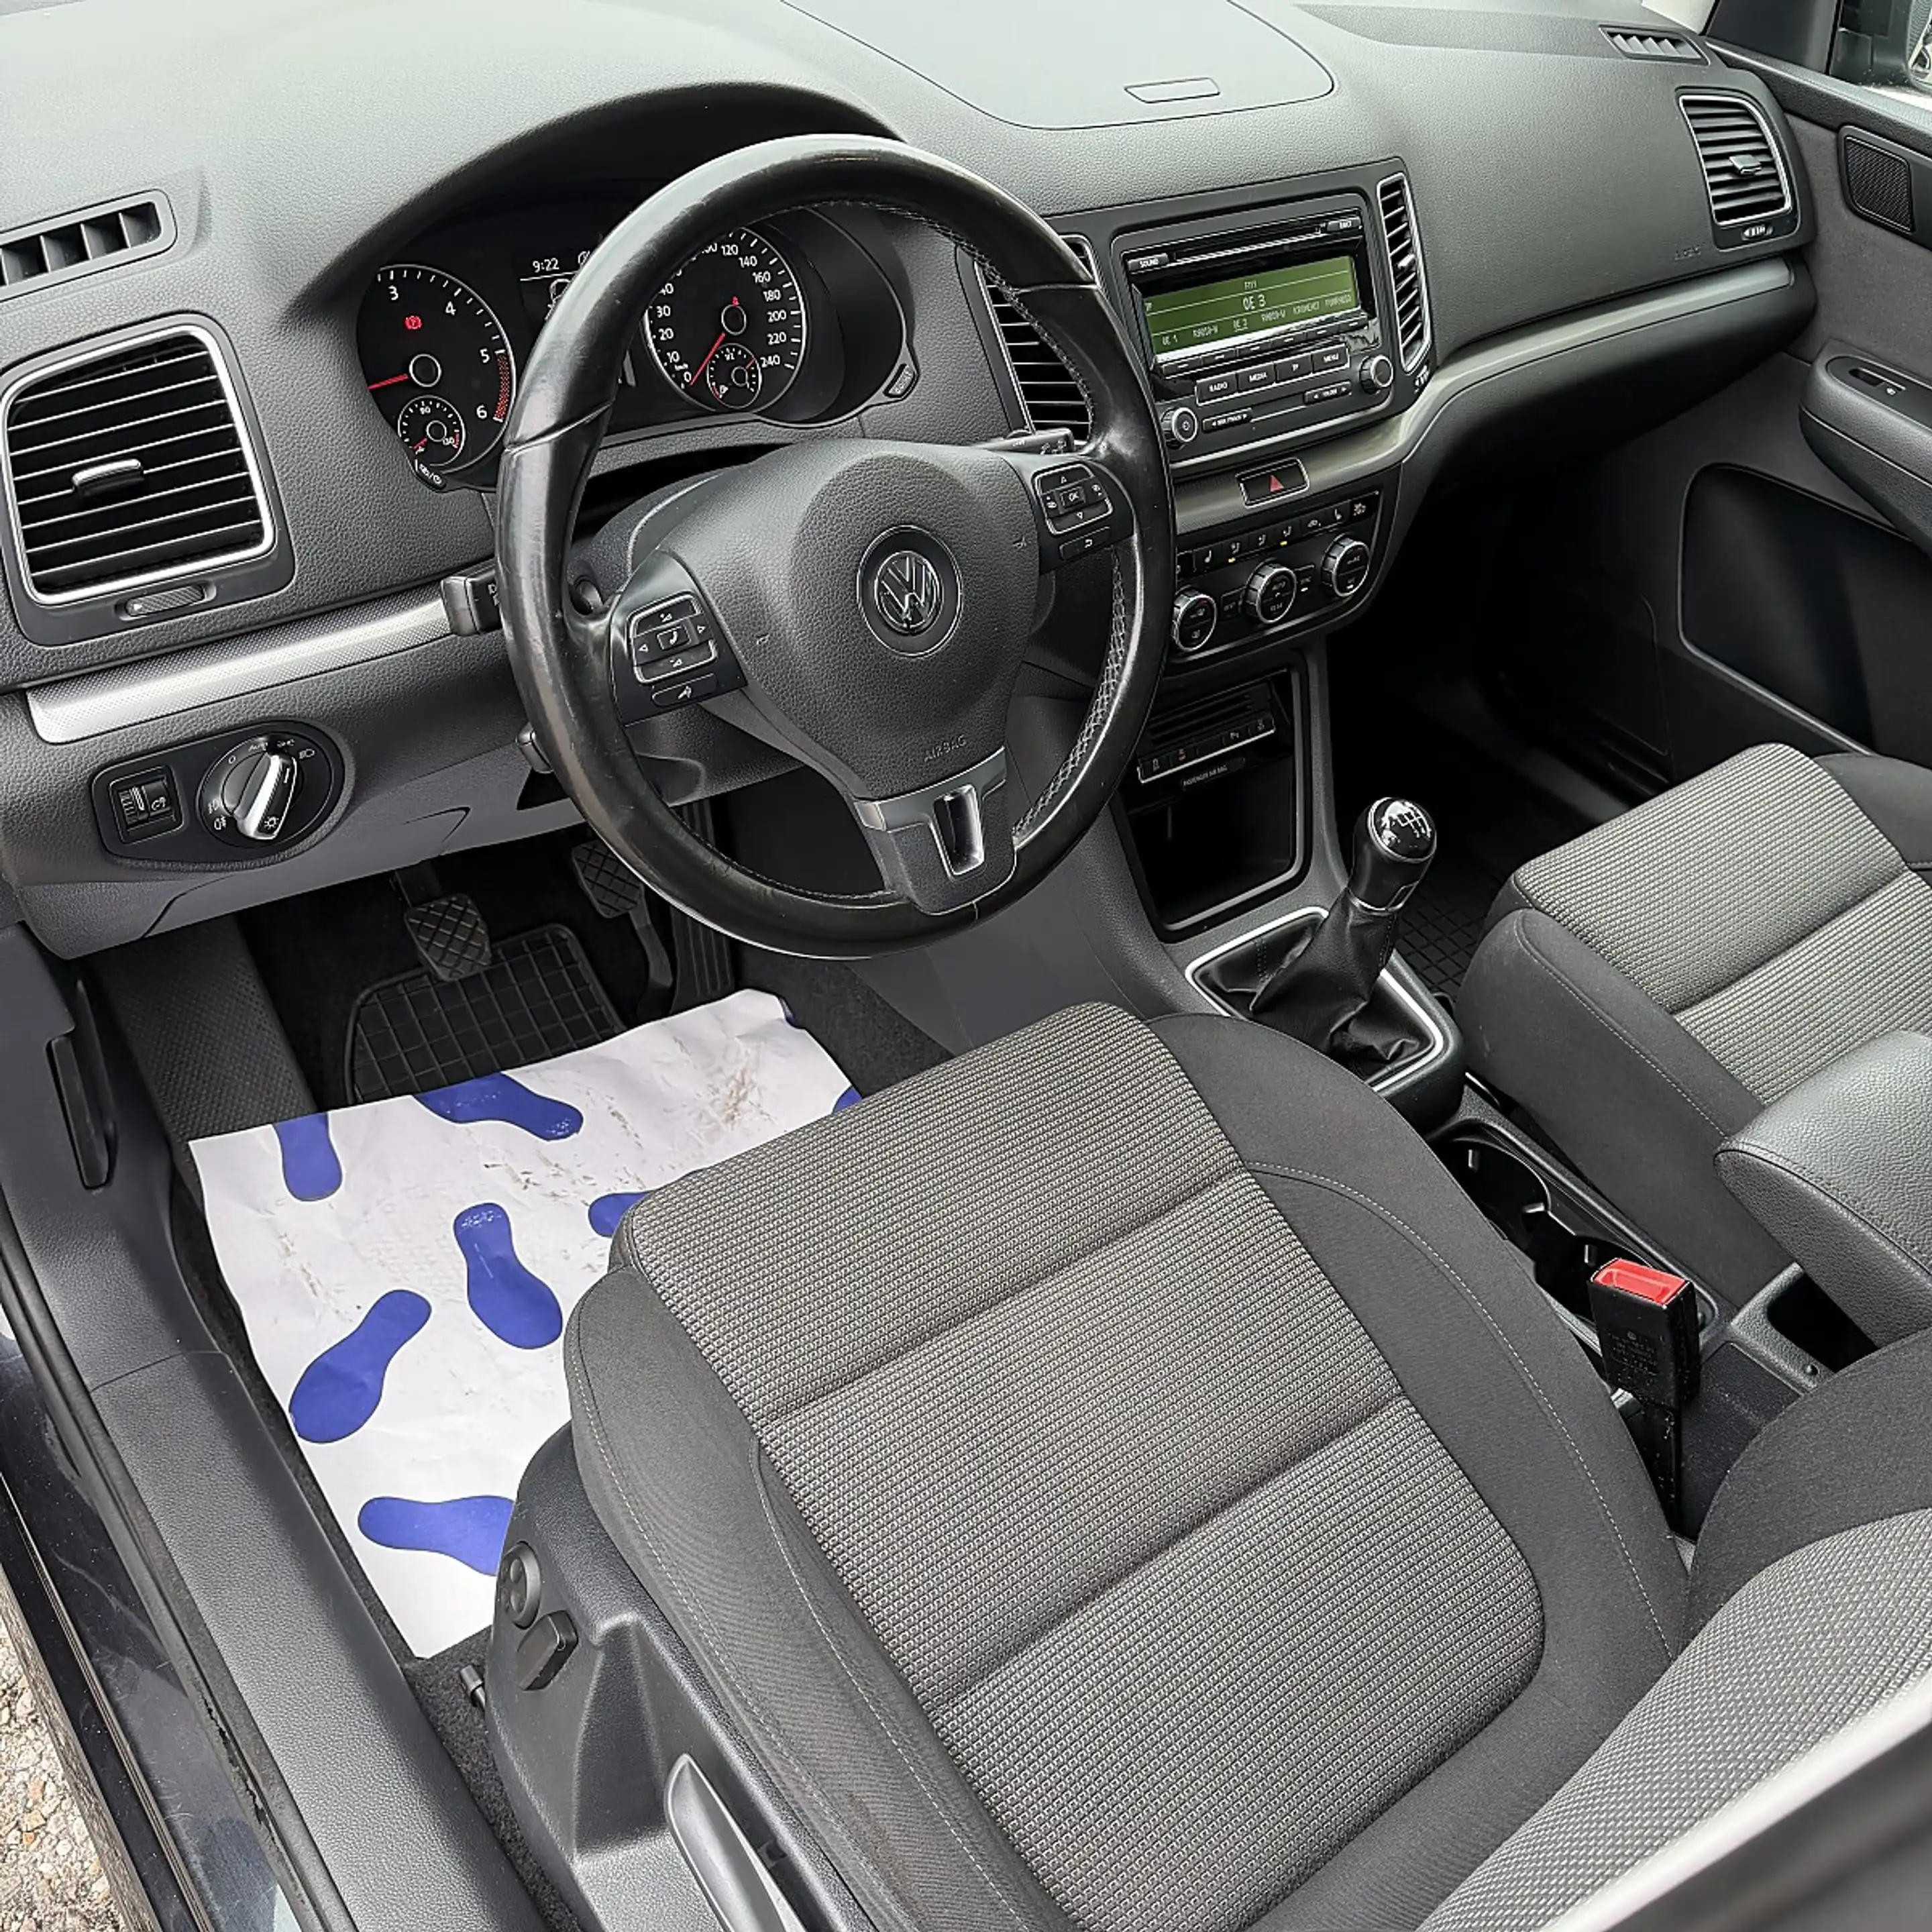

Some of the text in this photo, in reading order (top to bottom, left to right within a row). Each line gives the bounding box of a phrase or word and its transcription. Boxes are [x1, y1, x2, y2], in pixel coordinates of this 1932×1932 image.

[721, 244, 739, 256] 120
[533, 258, 559, 273] 9:22
[738, 256, 757, 267] 140
[752, 270, 771, 282] 160
[388, 285, 398, 301] 3
[763, 289, 781, 302] 180
[1258, 294, 1267, 307] 3
[445, 301, 456, 315] 4
[656, 305, 671, 318] 30
[767, 309, 787, 322] 200
[658, 327, 674, 341] 20
[767, 331, 787, 345] 220
[480, 348, 490, 363] 5
[666, 351, 680, 363] 10
[759, 354, 780, 368] 240
[684, 371, 692, 383] 0
[1248, 372, 1268, 382] MEDIA
[1209, 382, 1228, 392] RADIO
[476, 405, 488, 419] 6
